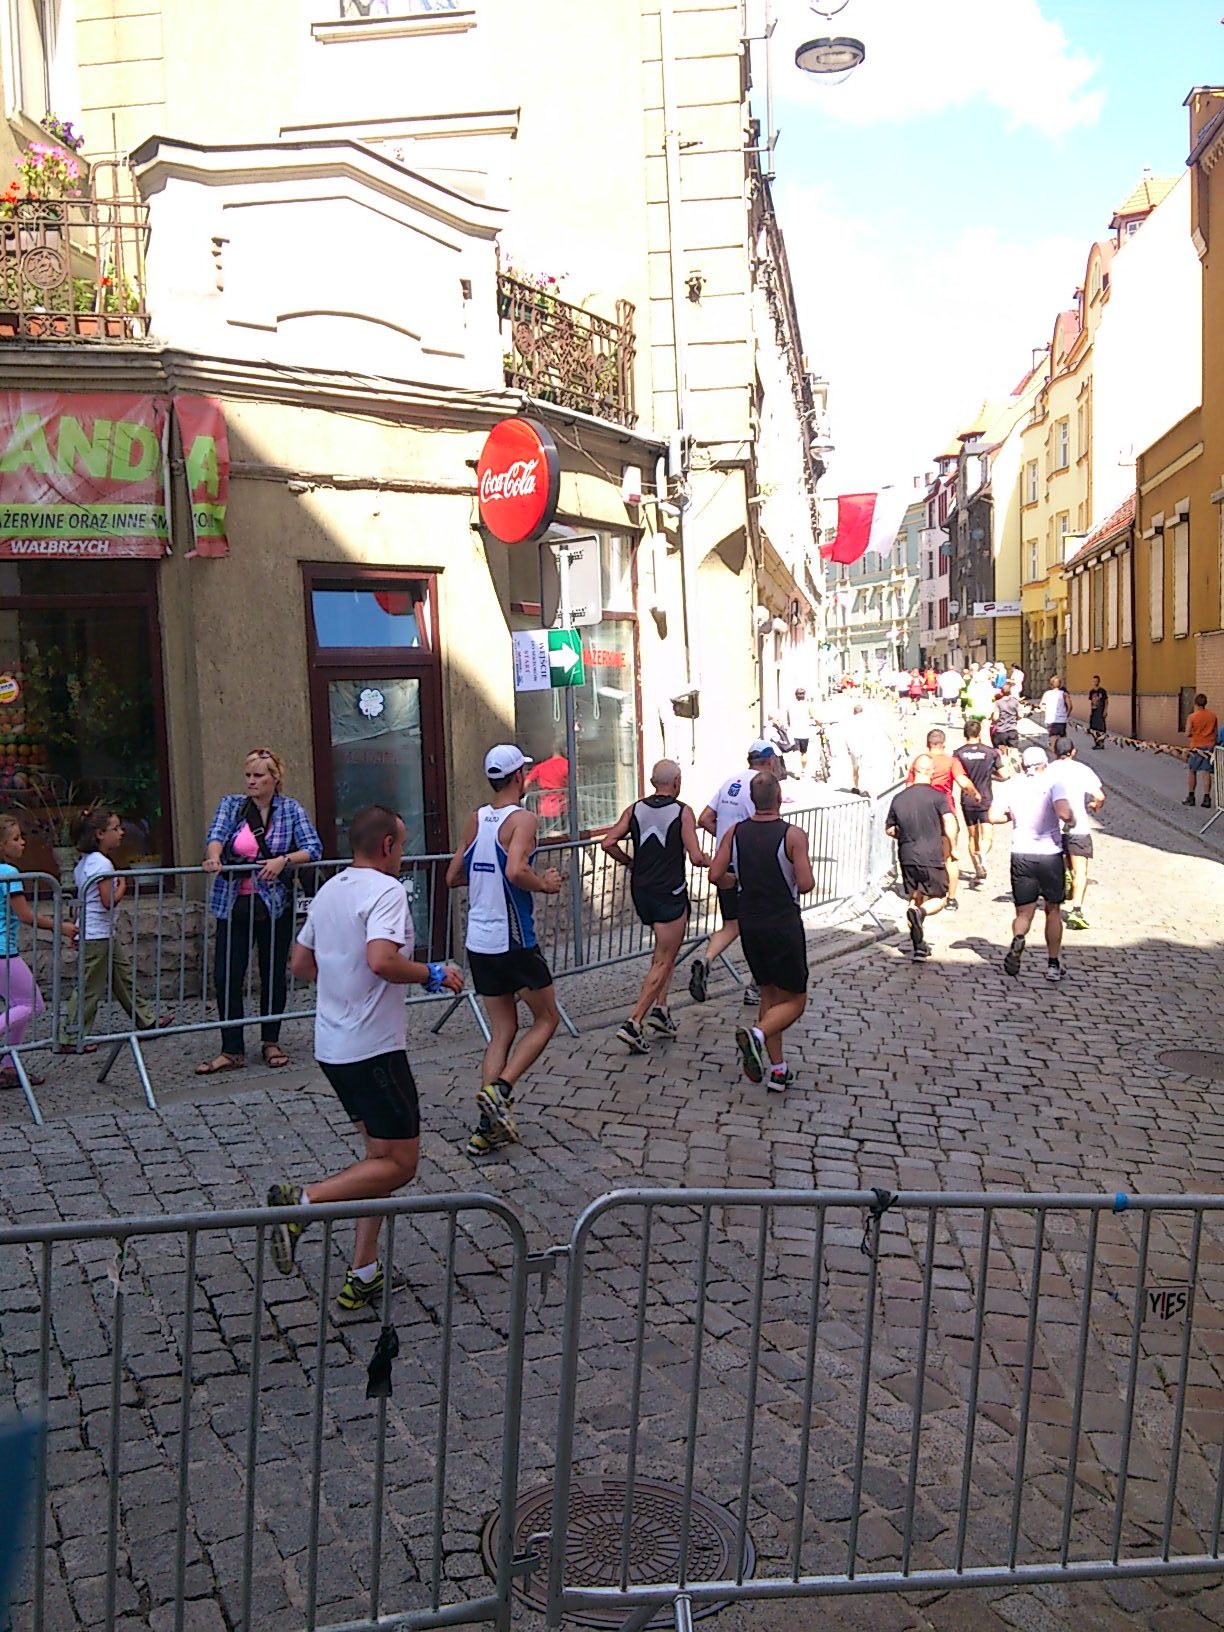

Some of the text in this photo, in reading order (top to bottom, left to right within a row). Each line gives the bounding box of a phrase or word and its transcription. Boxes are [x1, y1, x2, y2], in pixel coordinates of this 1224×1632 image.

[481, 459, 539, 503] Coca-Cola
[0, 509, 64, 529] ŻERYJNE
[69, 513, 107, 529] ORAZ
[112, 513, 146, 529] INNE
[11, 539, 109, 554] WAŁBRZYCH
